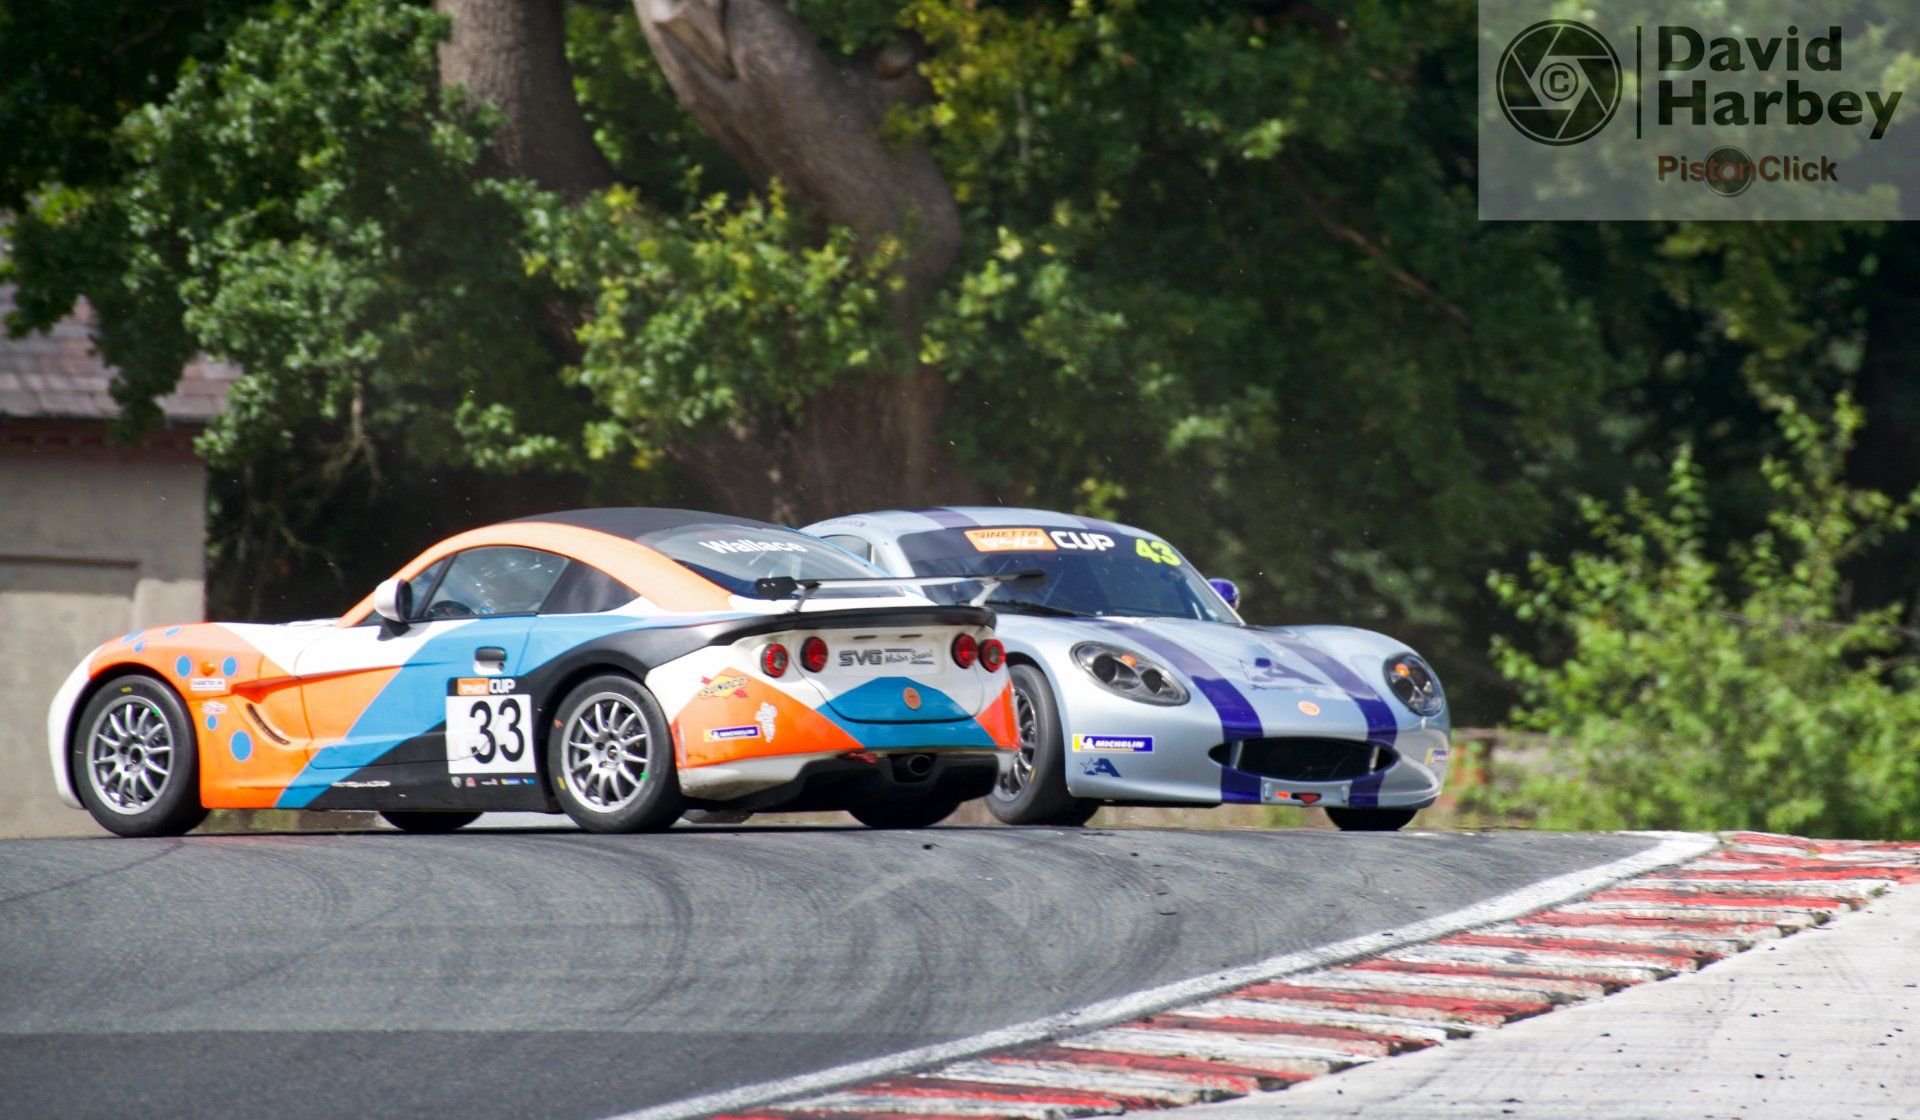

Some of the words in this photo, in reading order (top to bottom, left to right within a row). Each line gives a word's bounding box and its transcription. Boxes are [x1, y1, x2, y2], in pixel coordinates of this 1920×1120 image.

[698, 539, 808, 554] Wallace
[1050, 530, 1116, 551] CUP
[1135, 537, 1182, 567] 43
[839, 649, 882, 666] SVG
[489, 679, 516, 695] CUP
[470, 697, 524, 765] 33
